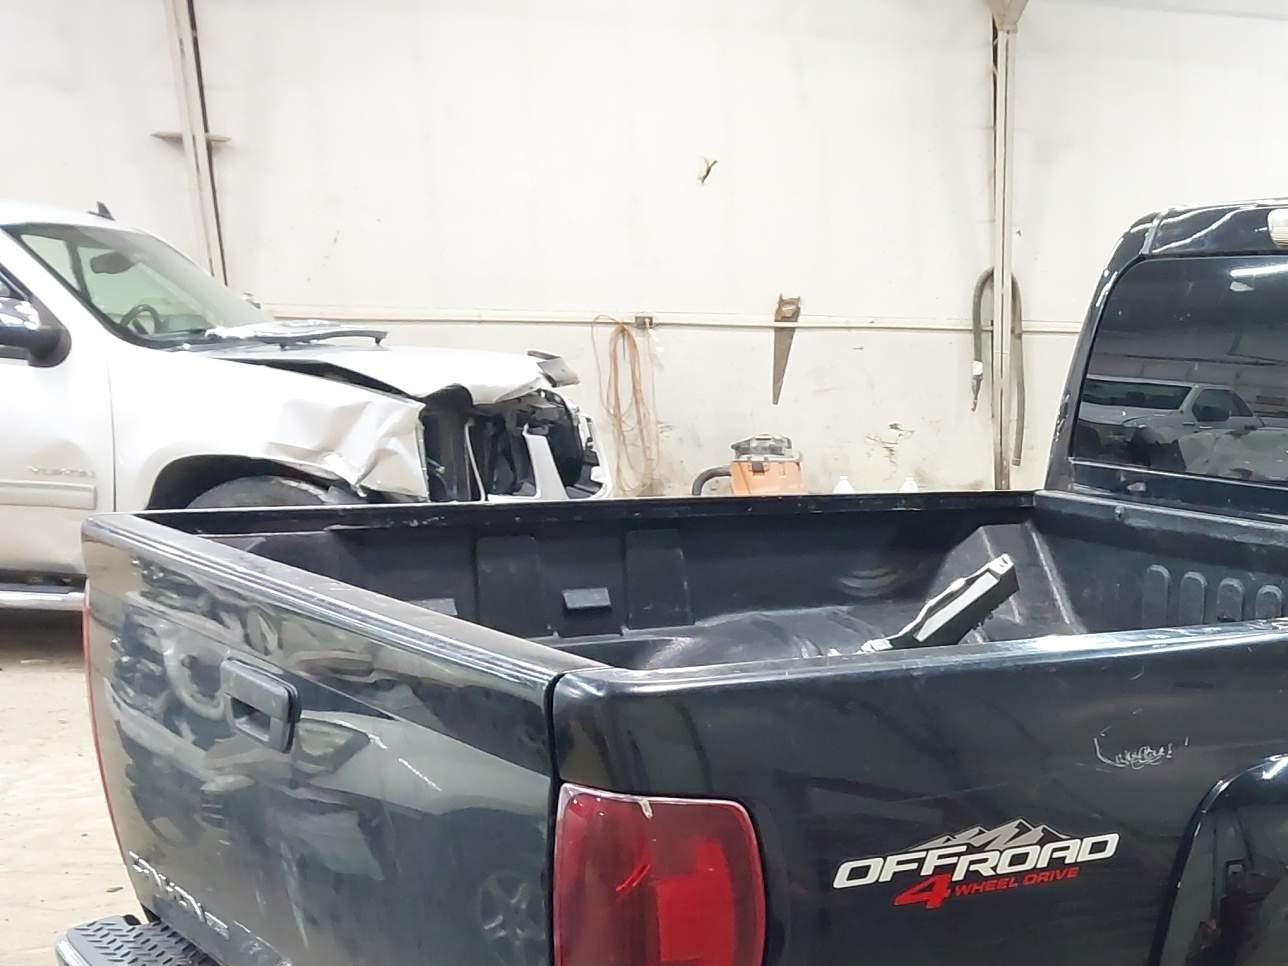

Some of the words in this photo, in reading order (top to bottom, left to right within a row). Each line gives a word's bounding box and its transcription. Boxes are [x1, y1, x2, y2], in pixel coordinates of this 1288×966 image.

[832, 832, 1120, 889] OFFROAD
[892, 872, 953, 909] 4
[955, 878, 1019, 897] WHEEL
[1023, 866, 1080, 887] DRIVE
